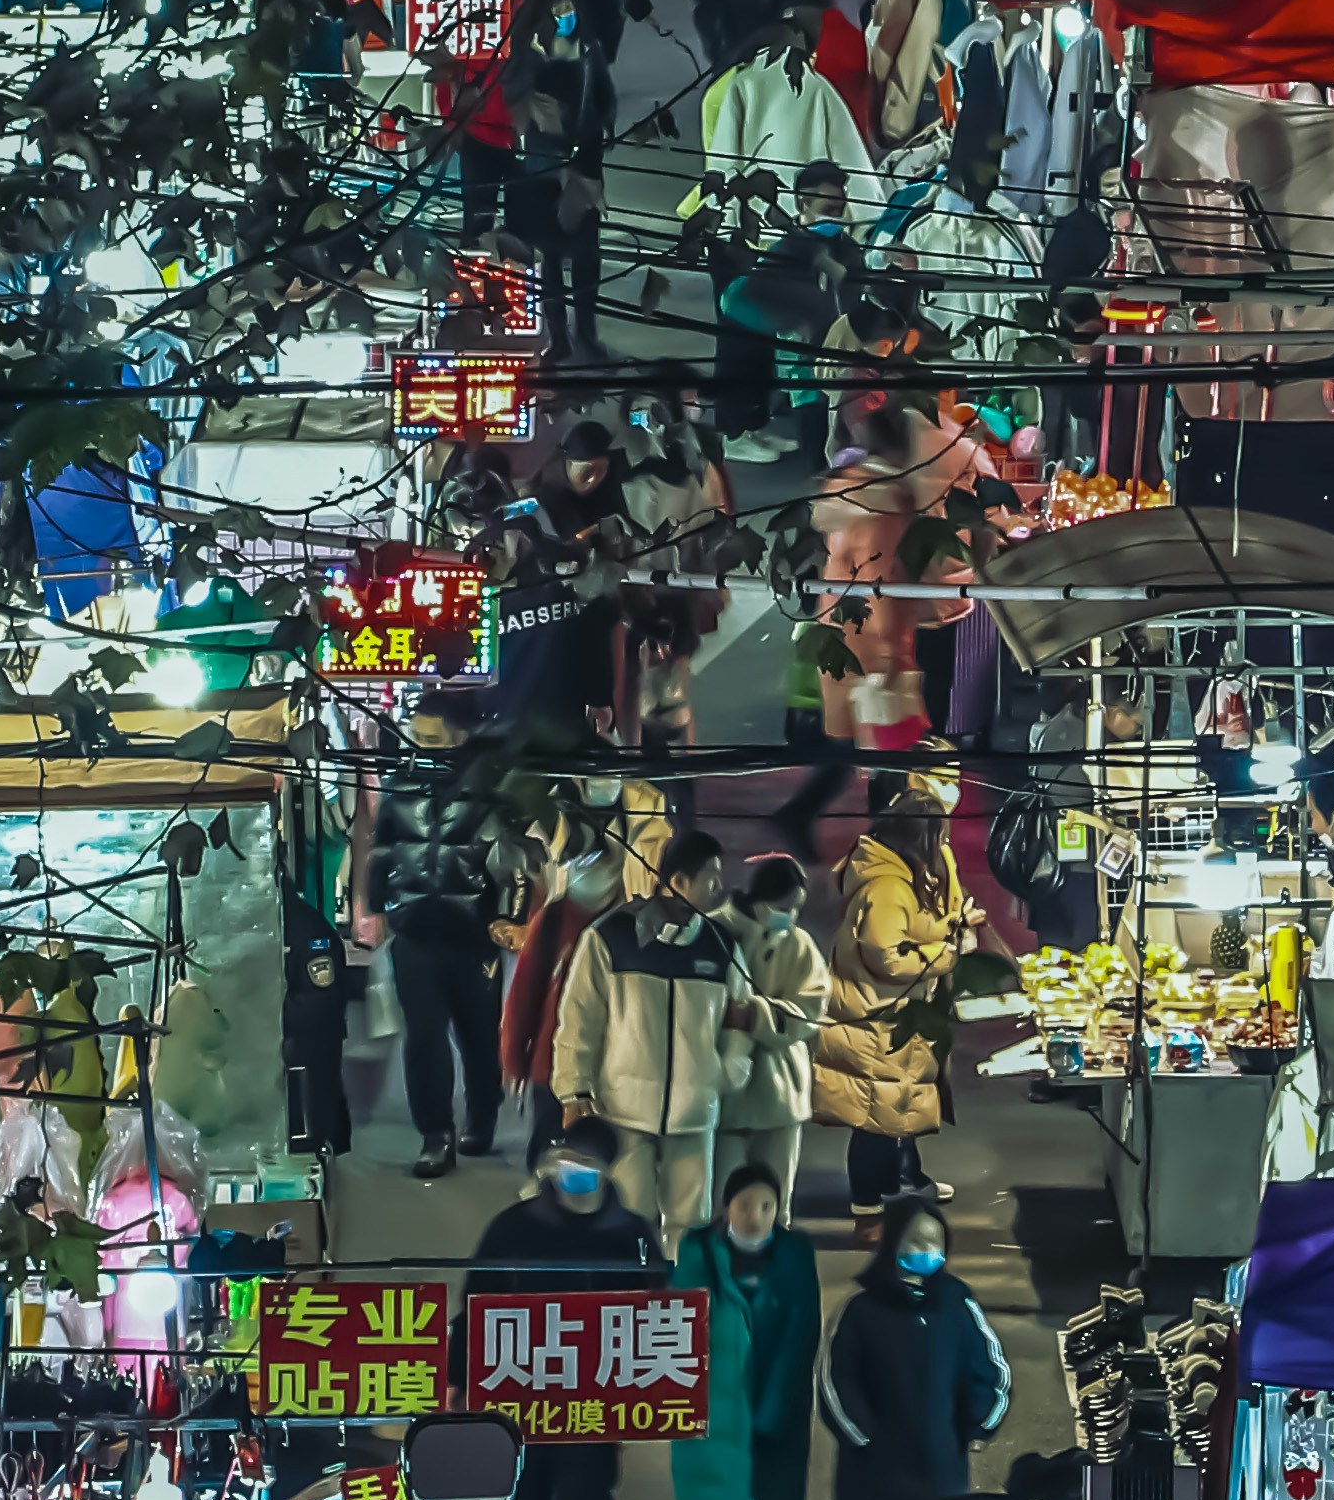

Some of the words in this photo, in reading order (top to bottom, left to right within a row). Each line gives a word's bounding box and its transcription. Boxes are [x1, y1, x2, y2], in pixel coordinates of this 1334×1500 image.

[265, 1287, 439, 1347] 专业
[479, 1300, 700, 1390] 贴膜
[268, 1361, 440, 1415] 贴膜
